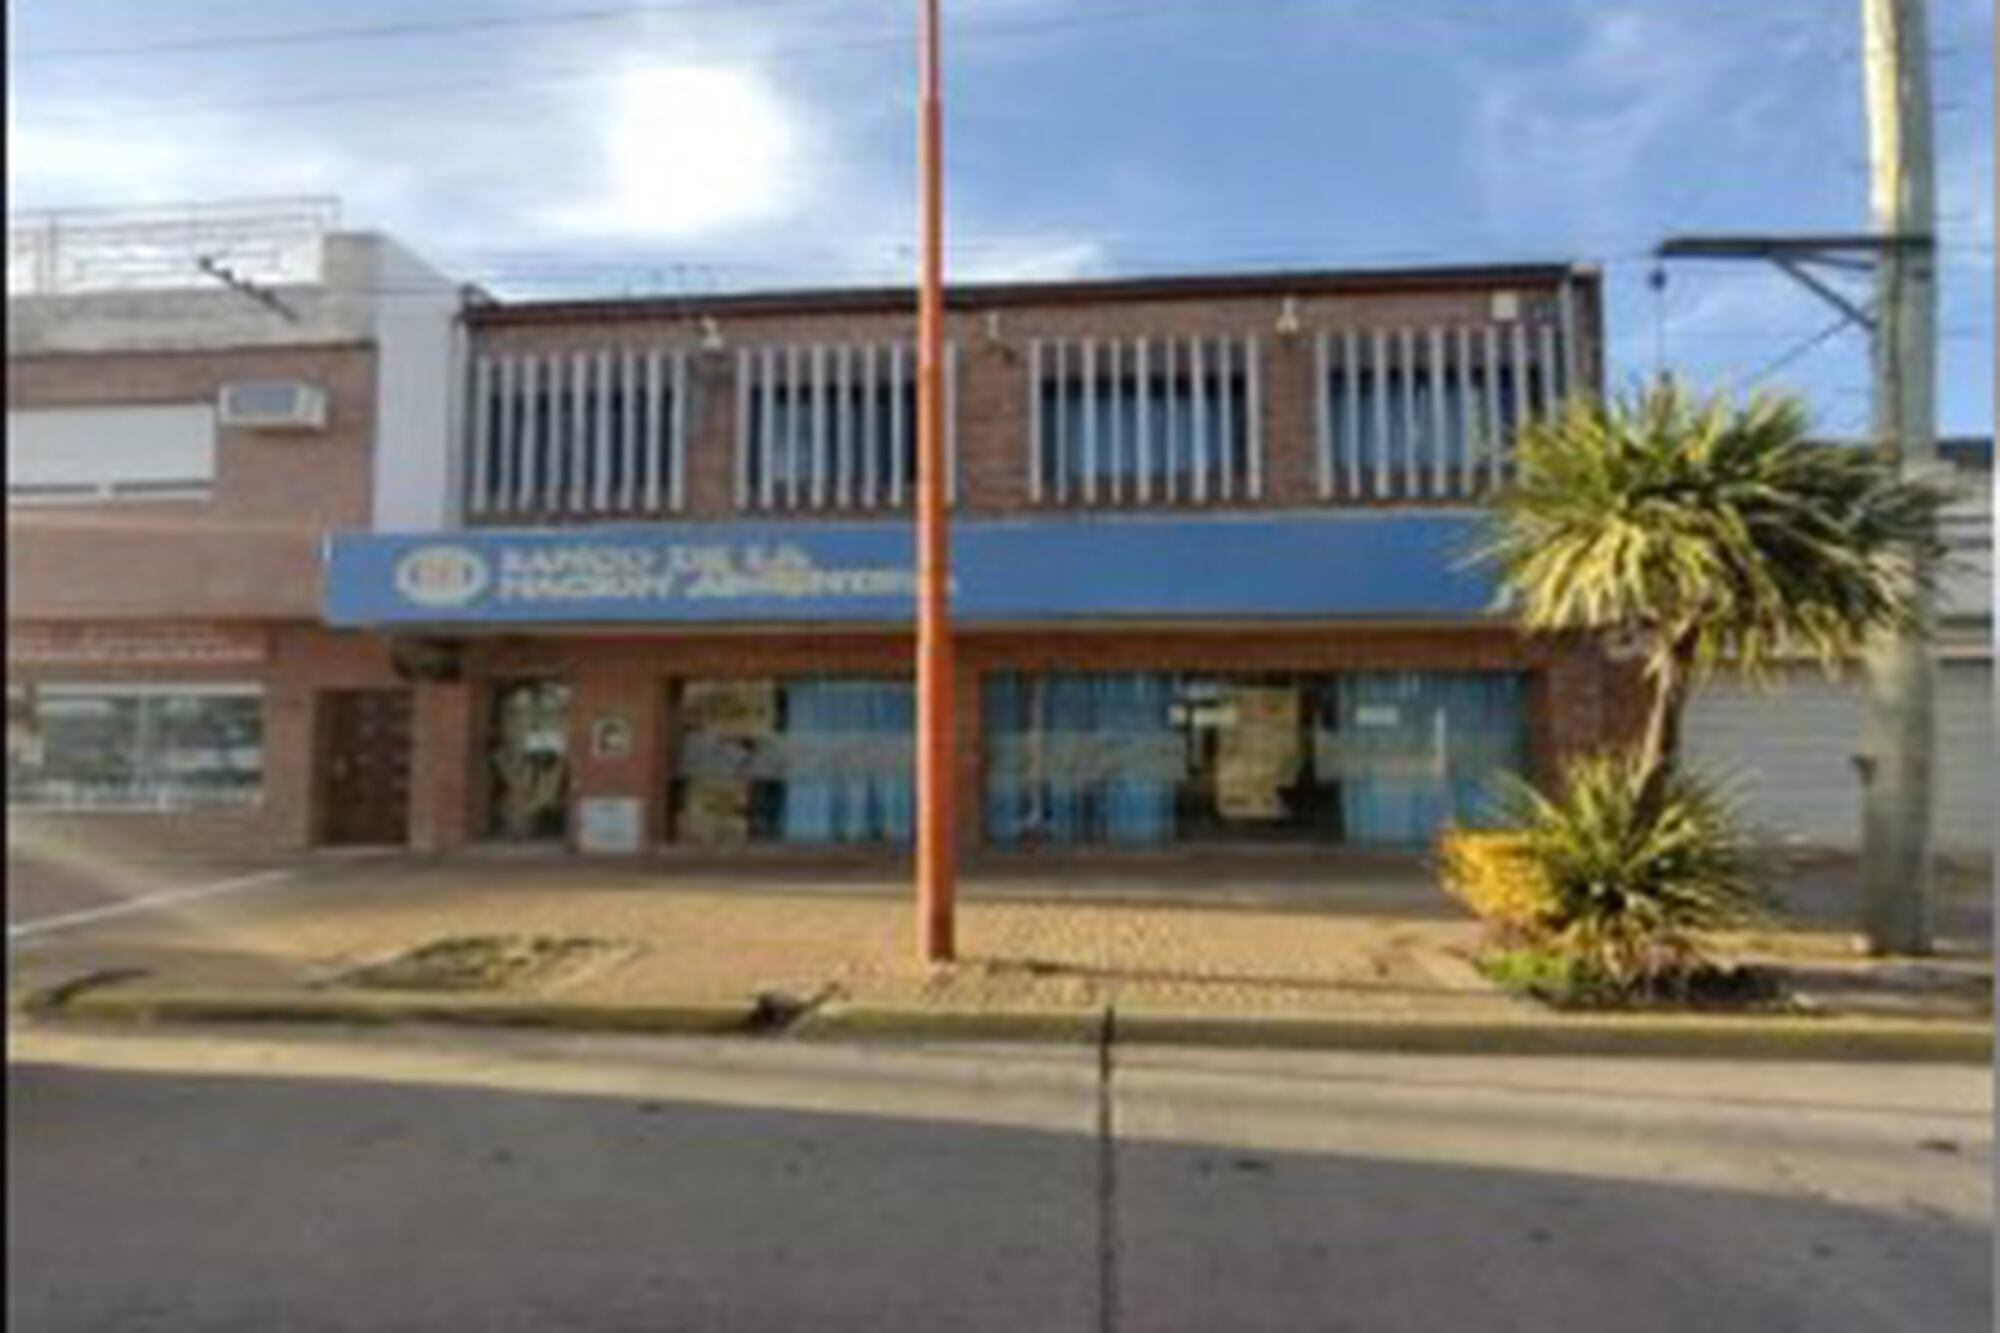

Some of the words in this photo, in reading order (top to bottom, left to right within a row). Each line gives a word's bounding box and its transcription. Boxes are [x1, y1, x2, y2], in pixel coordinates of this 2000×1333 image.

[500, 547, 652, 573] BANCO
[668, 546, 739, 572] DE
[745, 545, 812, 570] LA
[684, 567, 958, 598] ARGENTIN
